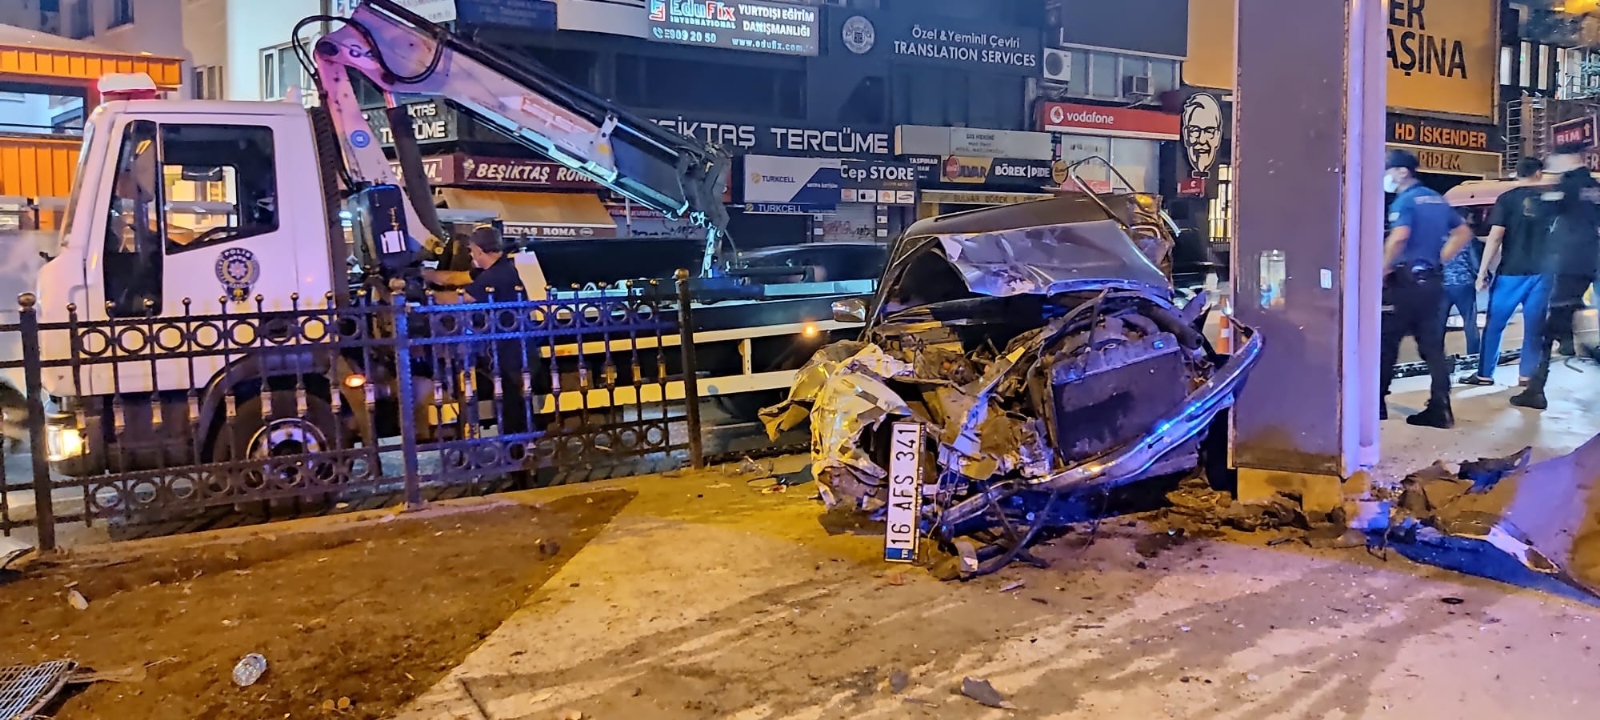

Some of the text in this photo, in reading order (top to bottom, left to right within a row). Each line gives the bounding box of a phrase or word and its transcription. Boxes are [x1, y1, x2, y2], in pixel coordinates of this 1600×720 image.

[669, 0, 736, 21] EduFix
[738, 3, 815, 23] YURTDIŞI EĞİTİM
[669, 15, 736, 29] INTERNATIONAL
[742, 20, 811, 37] DANIŞMANLIĞI
[690, 31, 703, 42] 20
[704, 32, 717, 43] 50
[912, 25, 938, 40] Özel
[894, 40, 1036, 67] TRANSLATION SERVICES
[1067, 111, 1115, 125] vodafone
[770, 126, 889, 154] TERCÜME
[1395, 121, 1487, 148] HD İSKENDER
[1556, 130, 1580, 145] BİM
[1418, 150, 1462, 170] PİDEM
[476, 160, 551, 183] BEŞİKTAŞ
[840, 164, 915, 182] Cep STORE
[994, 163, 1026, 177] BÖREK
[762, 175, 796, 183] TURKCELL
[758, 204, 802, 213] TURKCELL
[542, 227, 577, 236] ROMA
[890, 428, 918, 545] 16 AFS 341
[901, 549, 909, 559] TR
